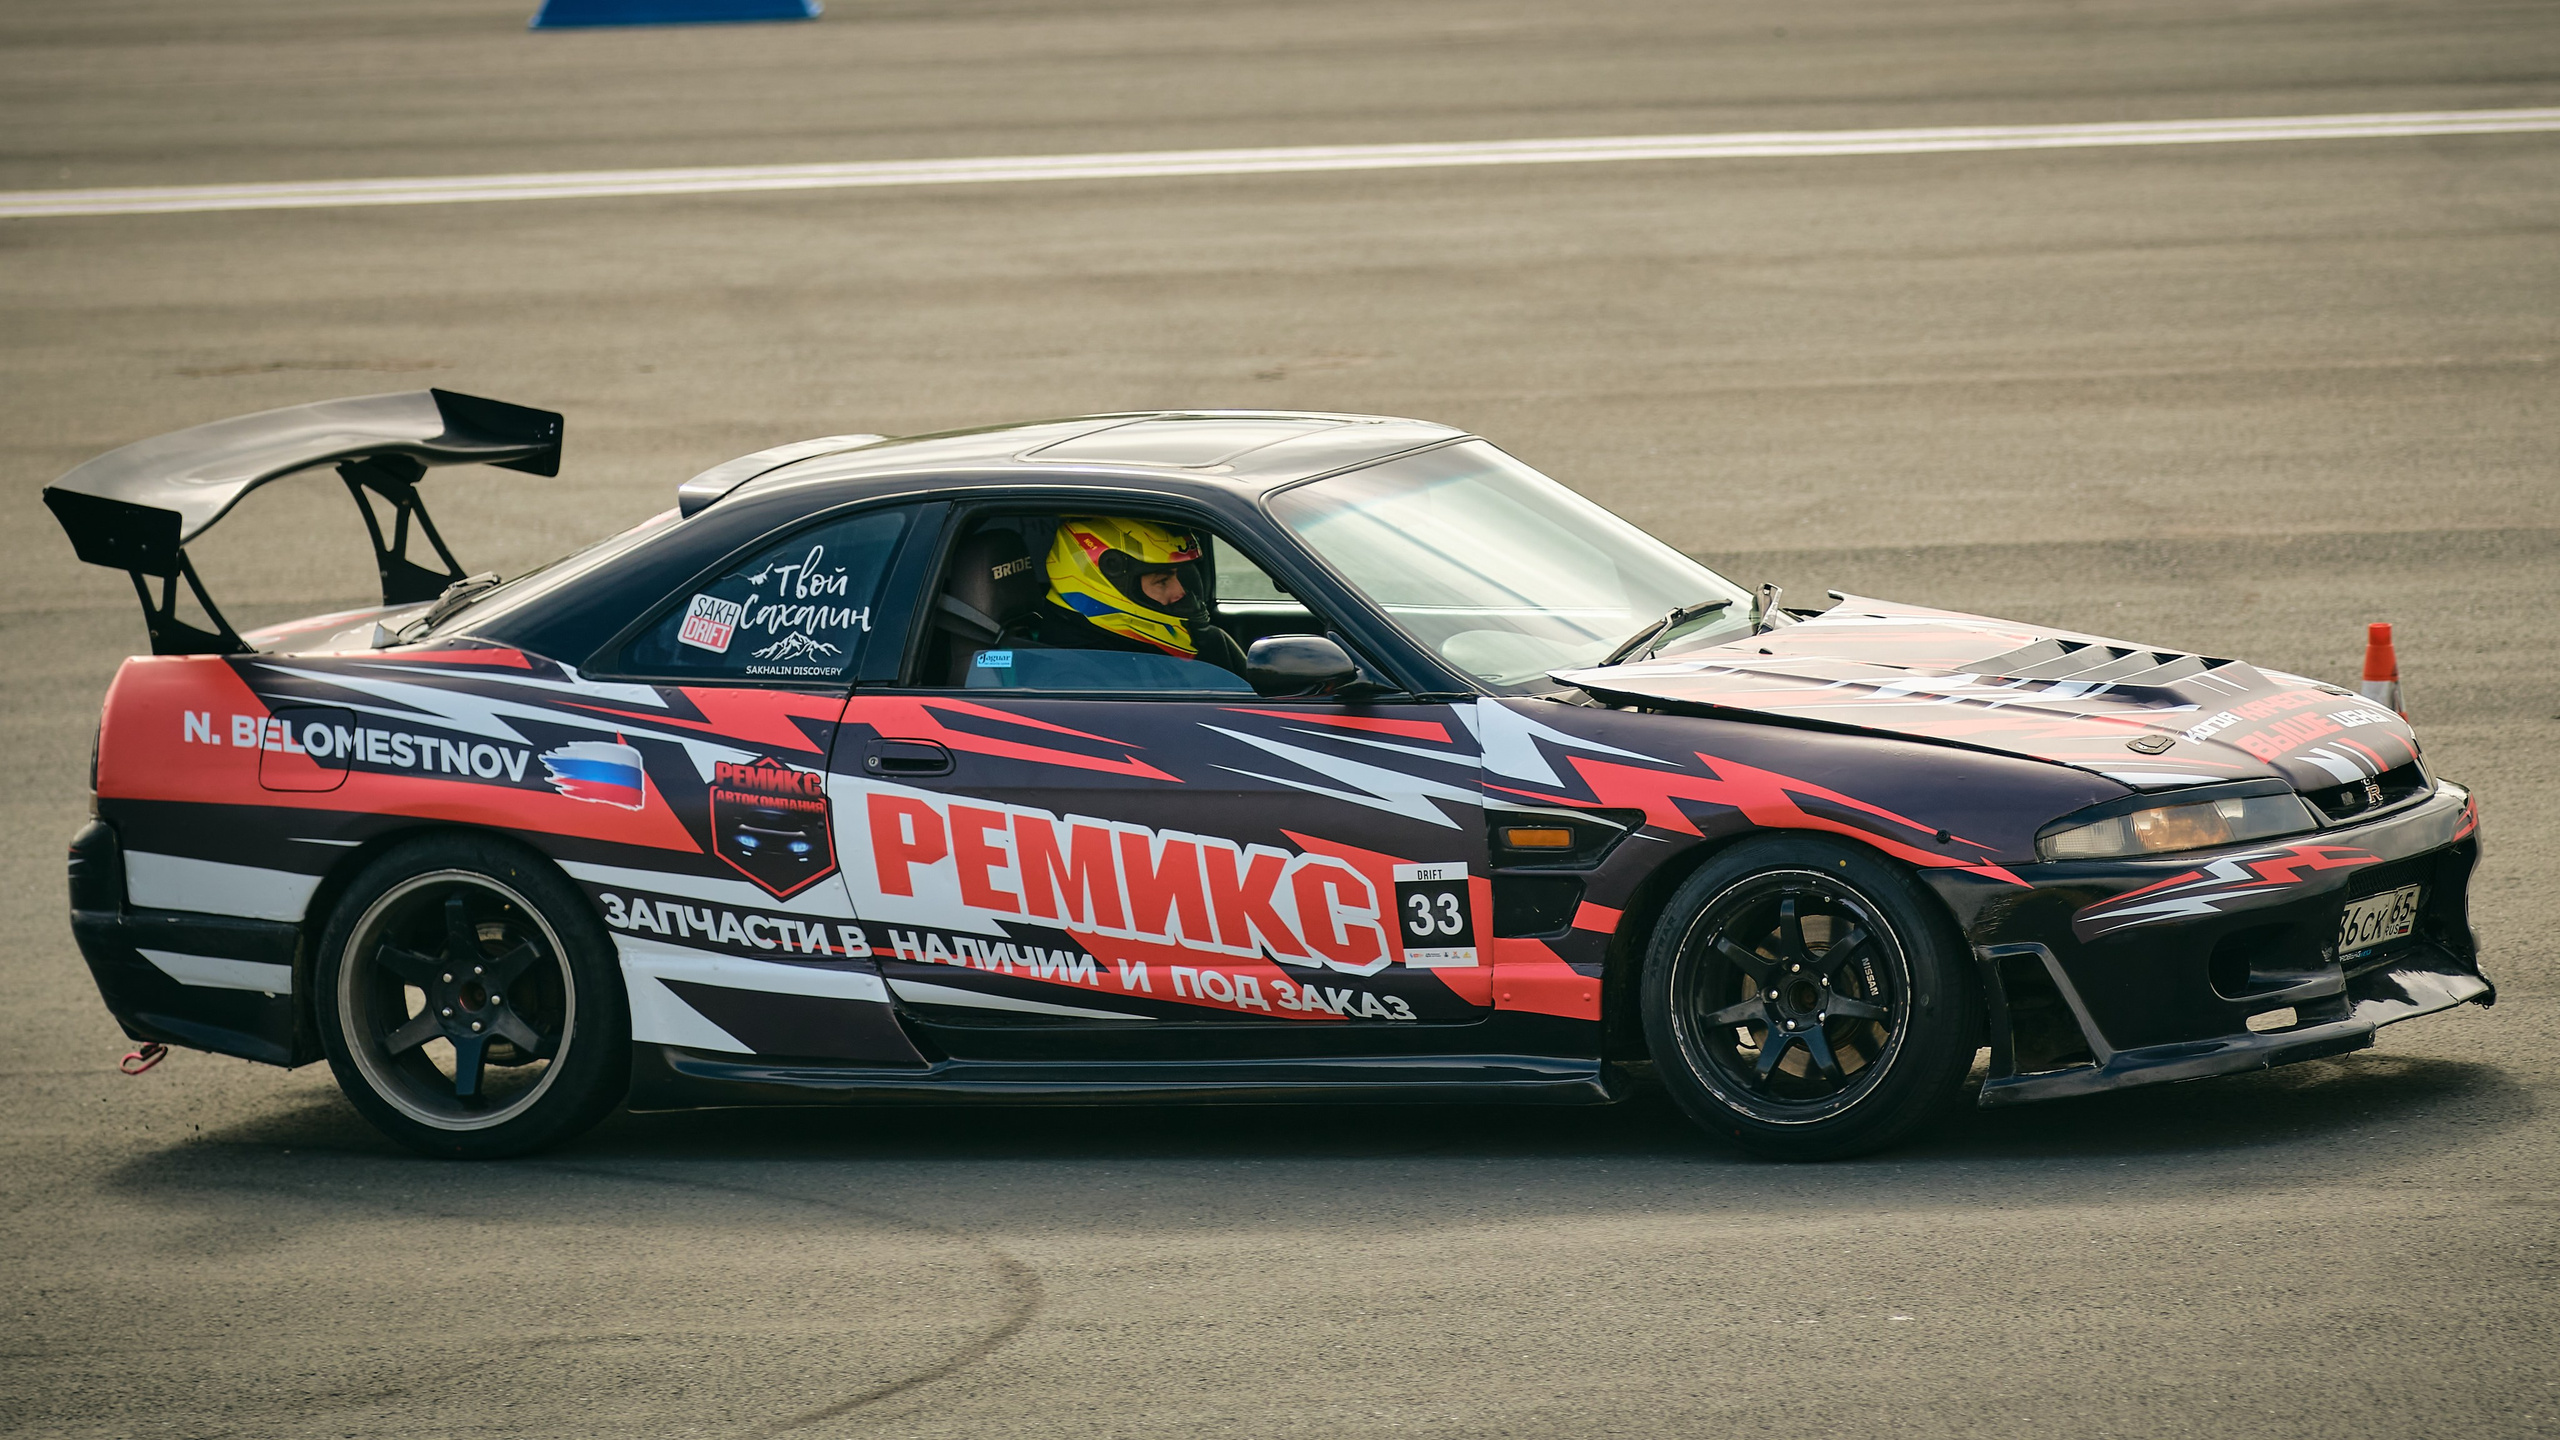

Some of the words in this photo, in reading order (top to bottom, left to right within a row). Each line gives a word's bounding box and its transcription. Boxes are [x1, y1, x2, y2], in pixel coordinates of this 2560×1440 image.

[773, 545, 848, 600] Твой
[991, 556, 1033, 580] BRIDE
[693, 597, 739, 626] SAKH
[739, 594, 872, 636] Сахалин
[684, 617, 731, 648] DRIFT
[745, 665, 791, 676] SAKHALIN
[793, 666, 843, 676] DISCOVERY
[978, 653, 1011, 664] Jaguar
[184, 710, 221, 746] N.
[231, 715, 530, 783] BELOMESTNOV
[2233, 711, 2344, 765] ВЫШЕ
[2326, 708, 2392, 728] ЦЕНЫ
[715, 761, 822, 797] РЕМИКС
[716, 789, 824, 814] АВТОКОМПАНИЯ
[866, 793, 1388, 973] РЕМИКС
[1417, 869, 1443, 880] DRIFT
[1408, 892, 1464, 936] 33
[2391, 891, 2414, 923] 65
[2385, 923, 2400, 936] RUS
[599, 893, 833, 956] ЗАПЧАСТИ
[837, 924, 873, 958] В
[887, 928, 1100, 986] НАЛИЧИИ
[1116, 958, 1153, 993] И
[1170, 966, 1272, 1012] ПОД
[1269, 980, 1418, 1020] ЗАКАЗ
[1861, 957, 1879, 996] NISSAN
